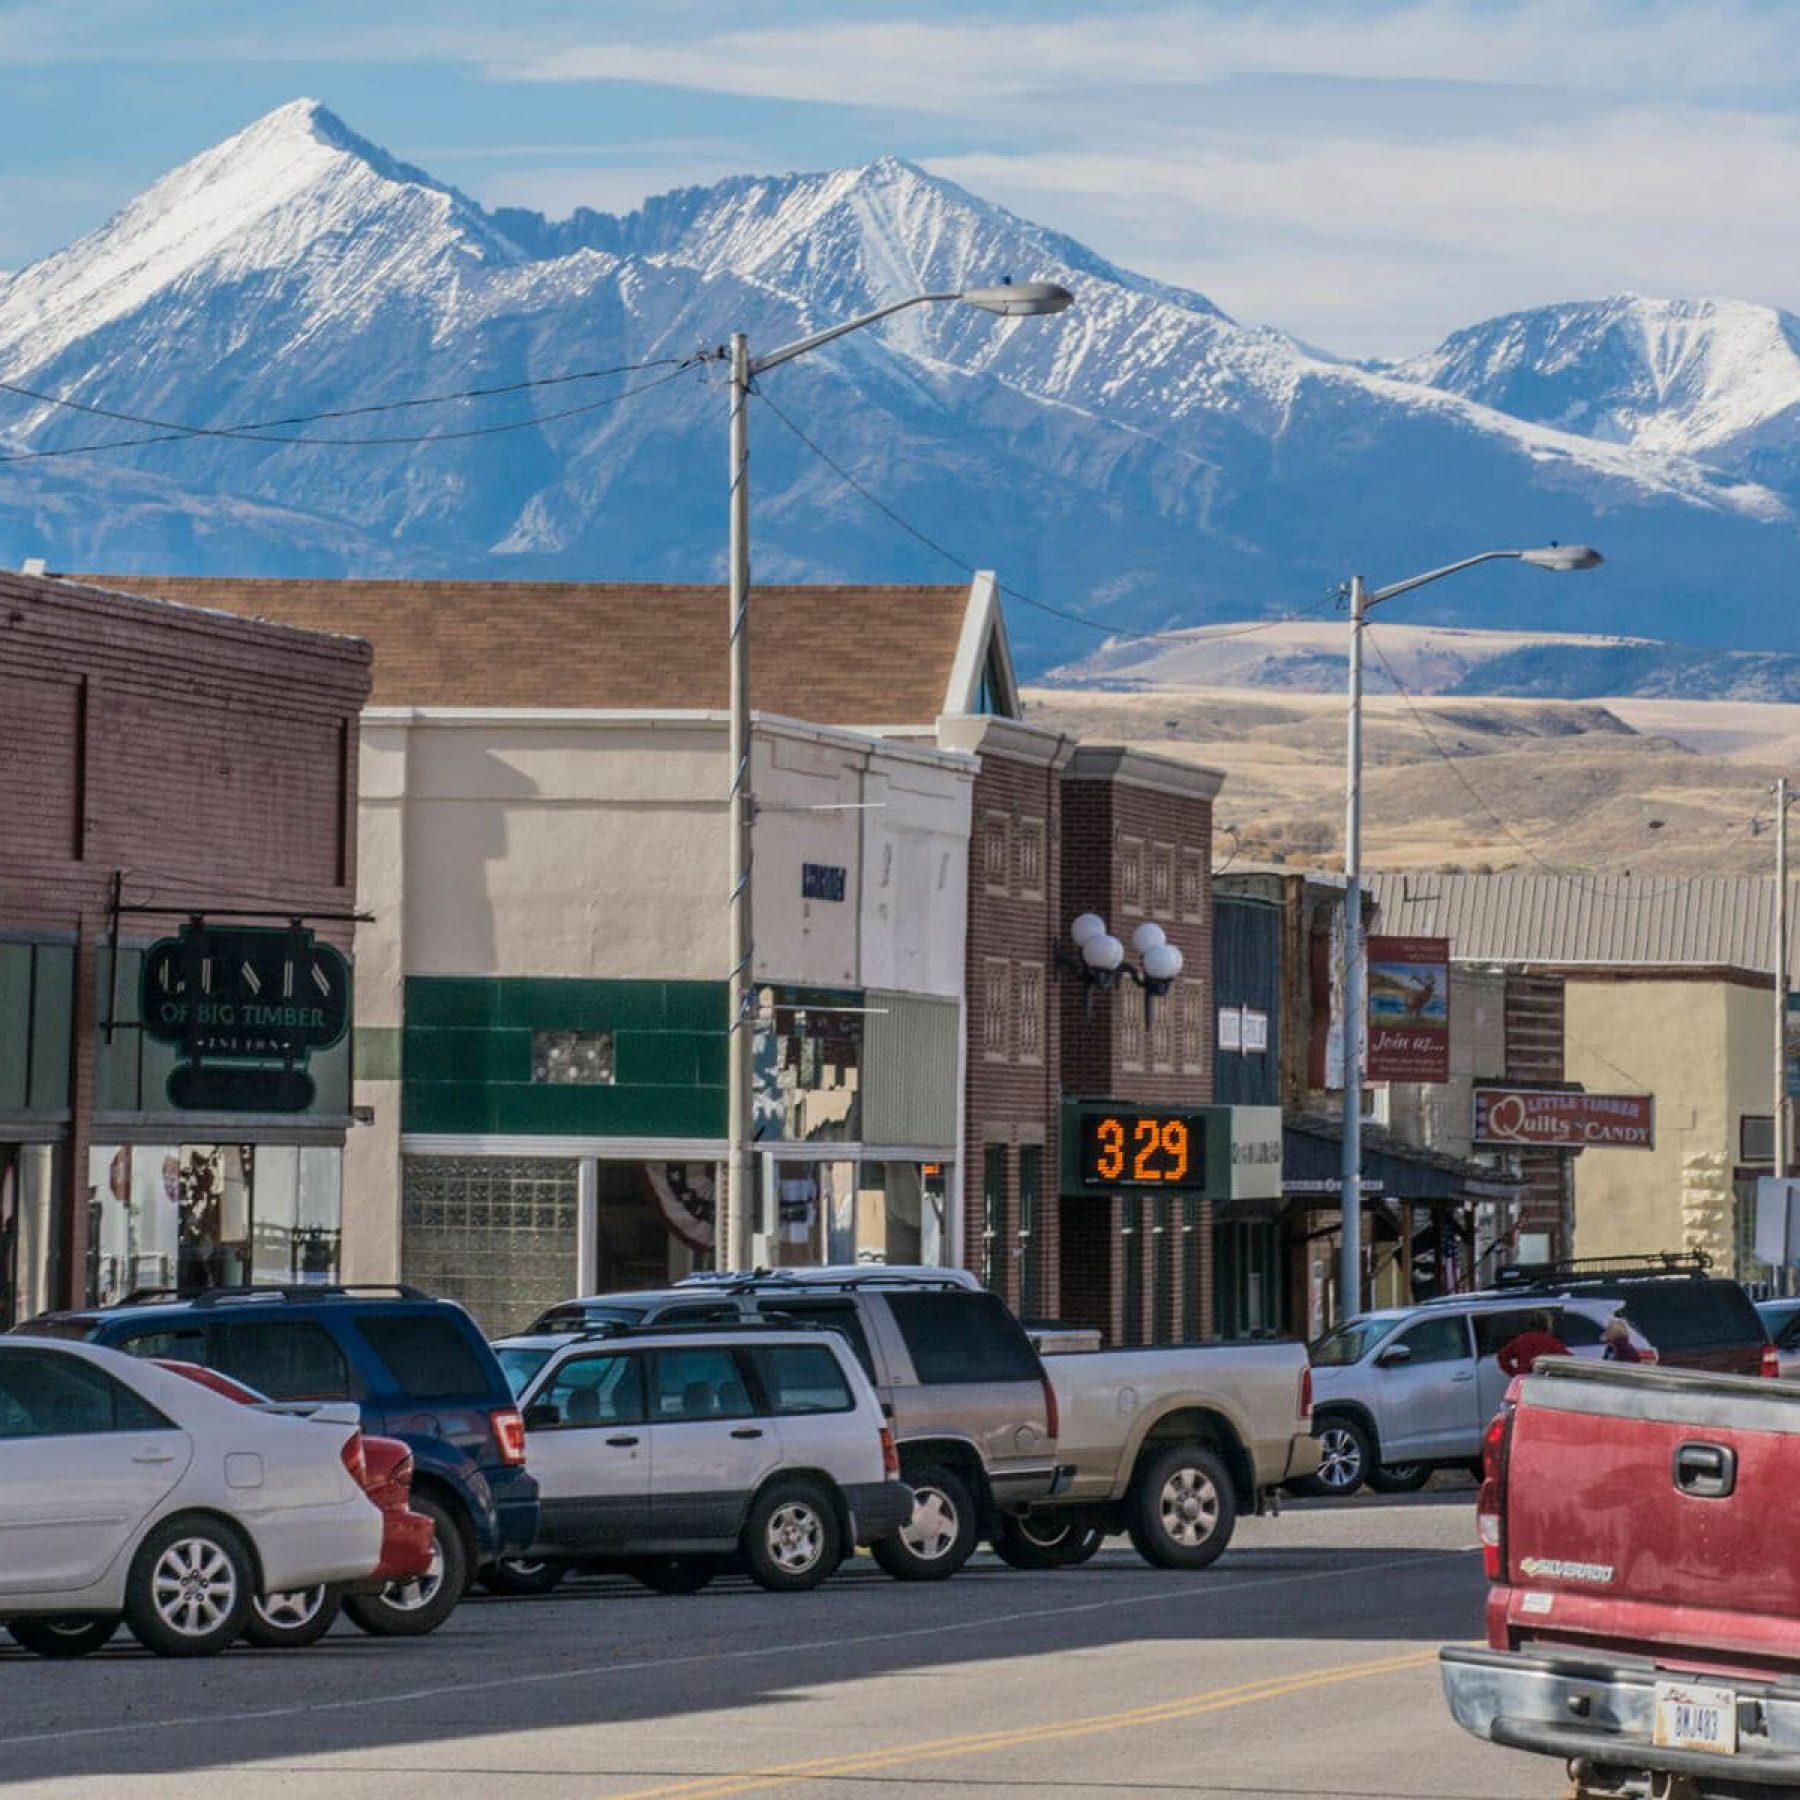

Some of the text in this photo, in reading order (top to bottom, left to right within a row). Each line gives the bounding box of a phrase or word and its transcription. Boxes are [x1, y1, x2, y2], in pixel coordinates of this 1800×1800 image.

[161, 1003, 326, 1027] OF BIG TIMBER
[1489, 1095, 1570, 1142] Quilts
[1585, 1121, 1649, 1141] CANDY
